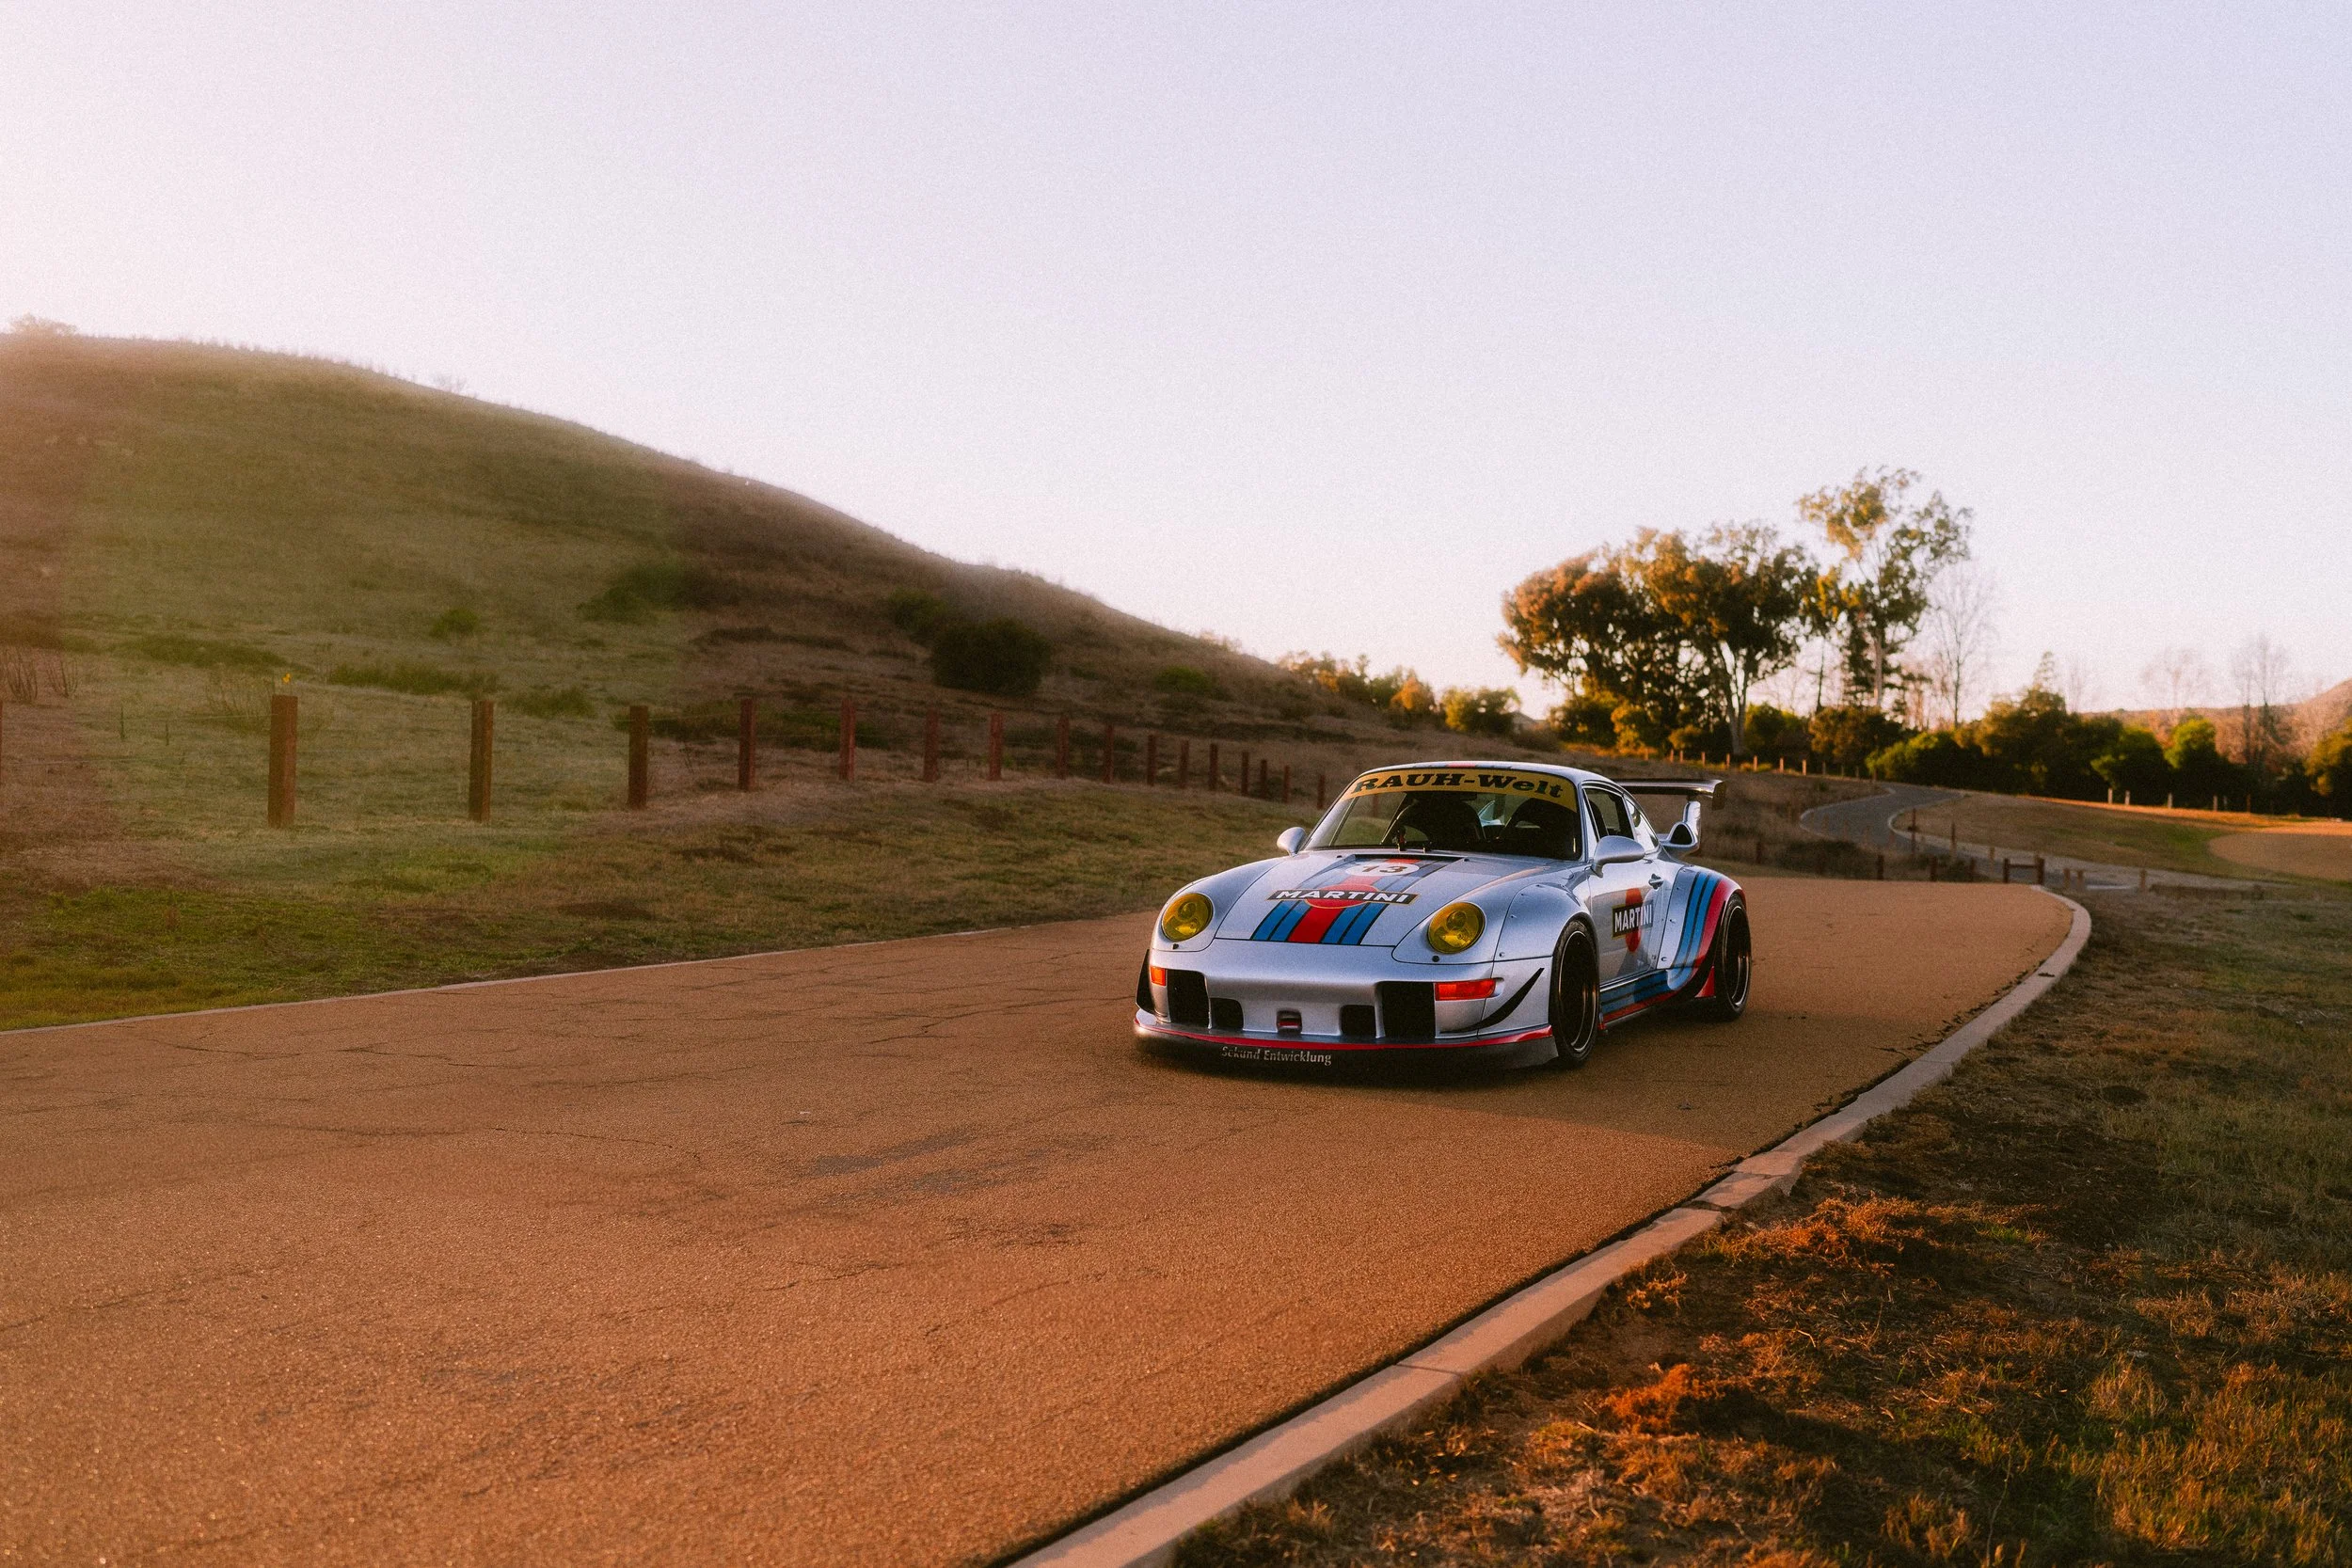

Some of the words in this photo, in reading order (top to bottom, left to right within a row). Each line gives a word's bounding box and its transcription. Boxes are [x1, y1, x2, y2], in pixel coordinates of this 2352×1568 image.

[1351, 773, 1563, 799] RAUH-Welt
[1361, 865, 1408, 874] 13
[1276, 891, 1409, 903] MARTINI
[1614, 904, 1652, 933] MARTINI
[1263, 1050, 1332, 1066] Entwicklung
